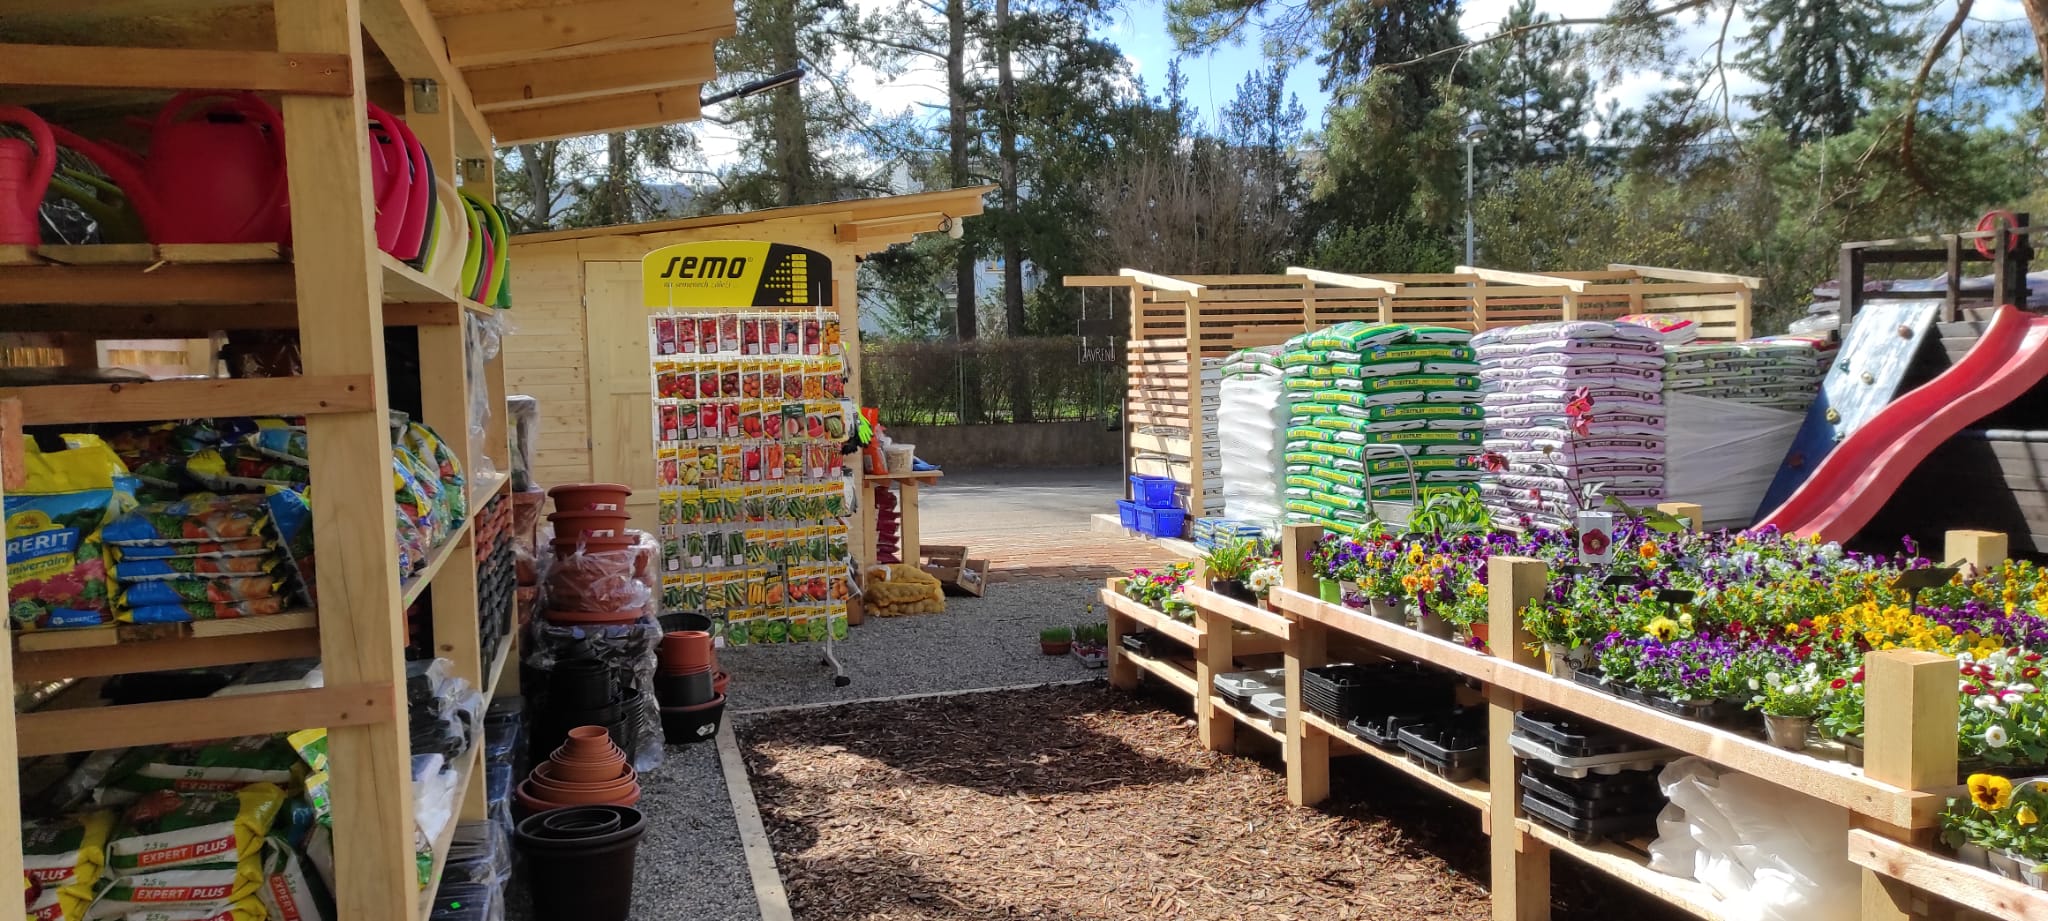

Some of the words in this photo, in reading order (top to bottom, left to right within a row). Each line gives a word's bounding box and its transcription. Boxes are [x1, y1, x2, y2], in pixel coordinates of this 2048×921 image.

[660, 256, 747, 278] semo
[7, 532, 73, 556] RERIT
[143, 848, 188, 864] EXPERT
[196, 839, 228, 855] PLUS
[137, 889, 185, 900] EXPERT
[192, 887, 225, 899] PLUS
